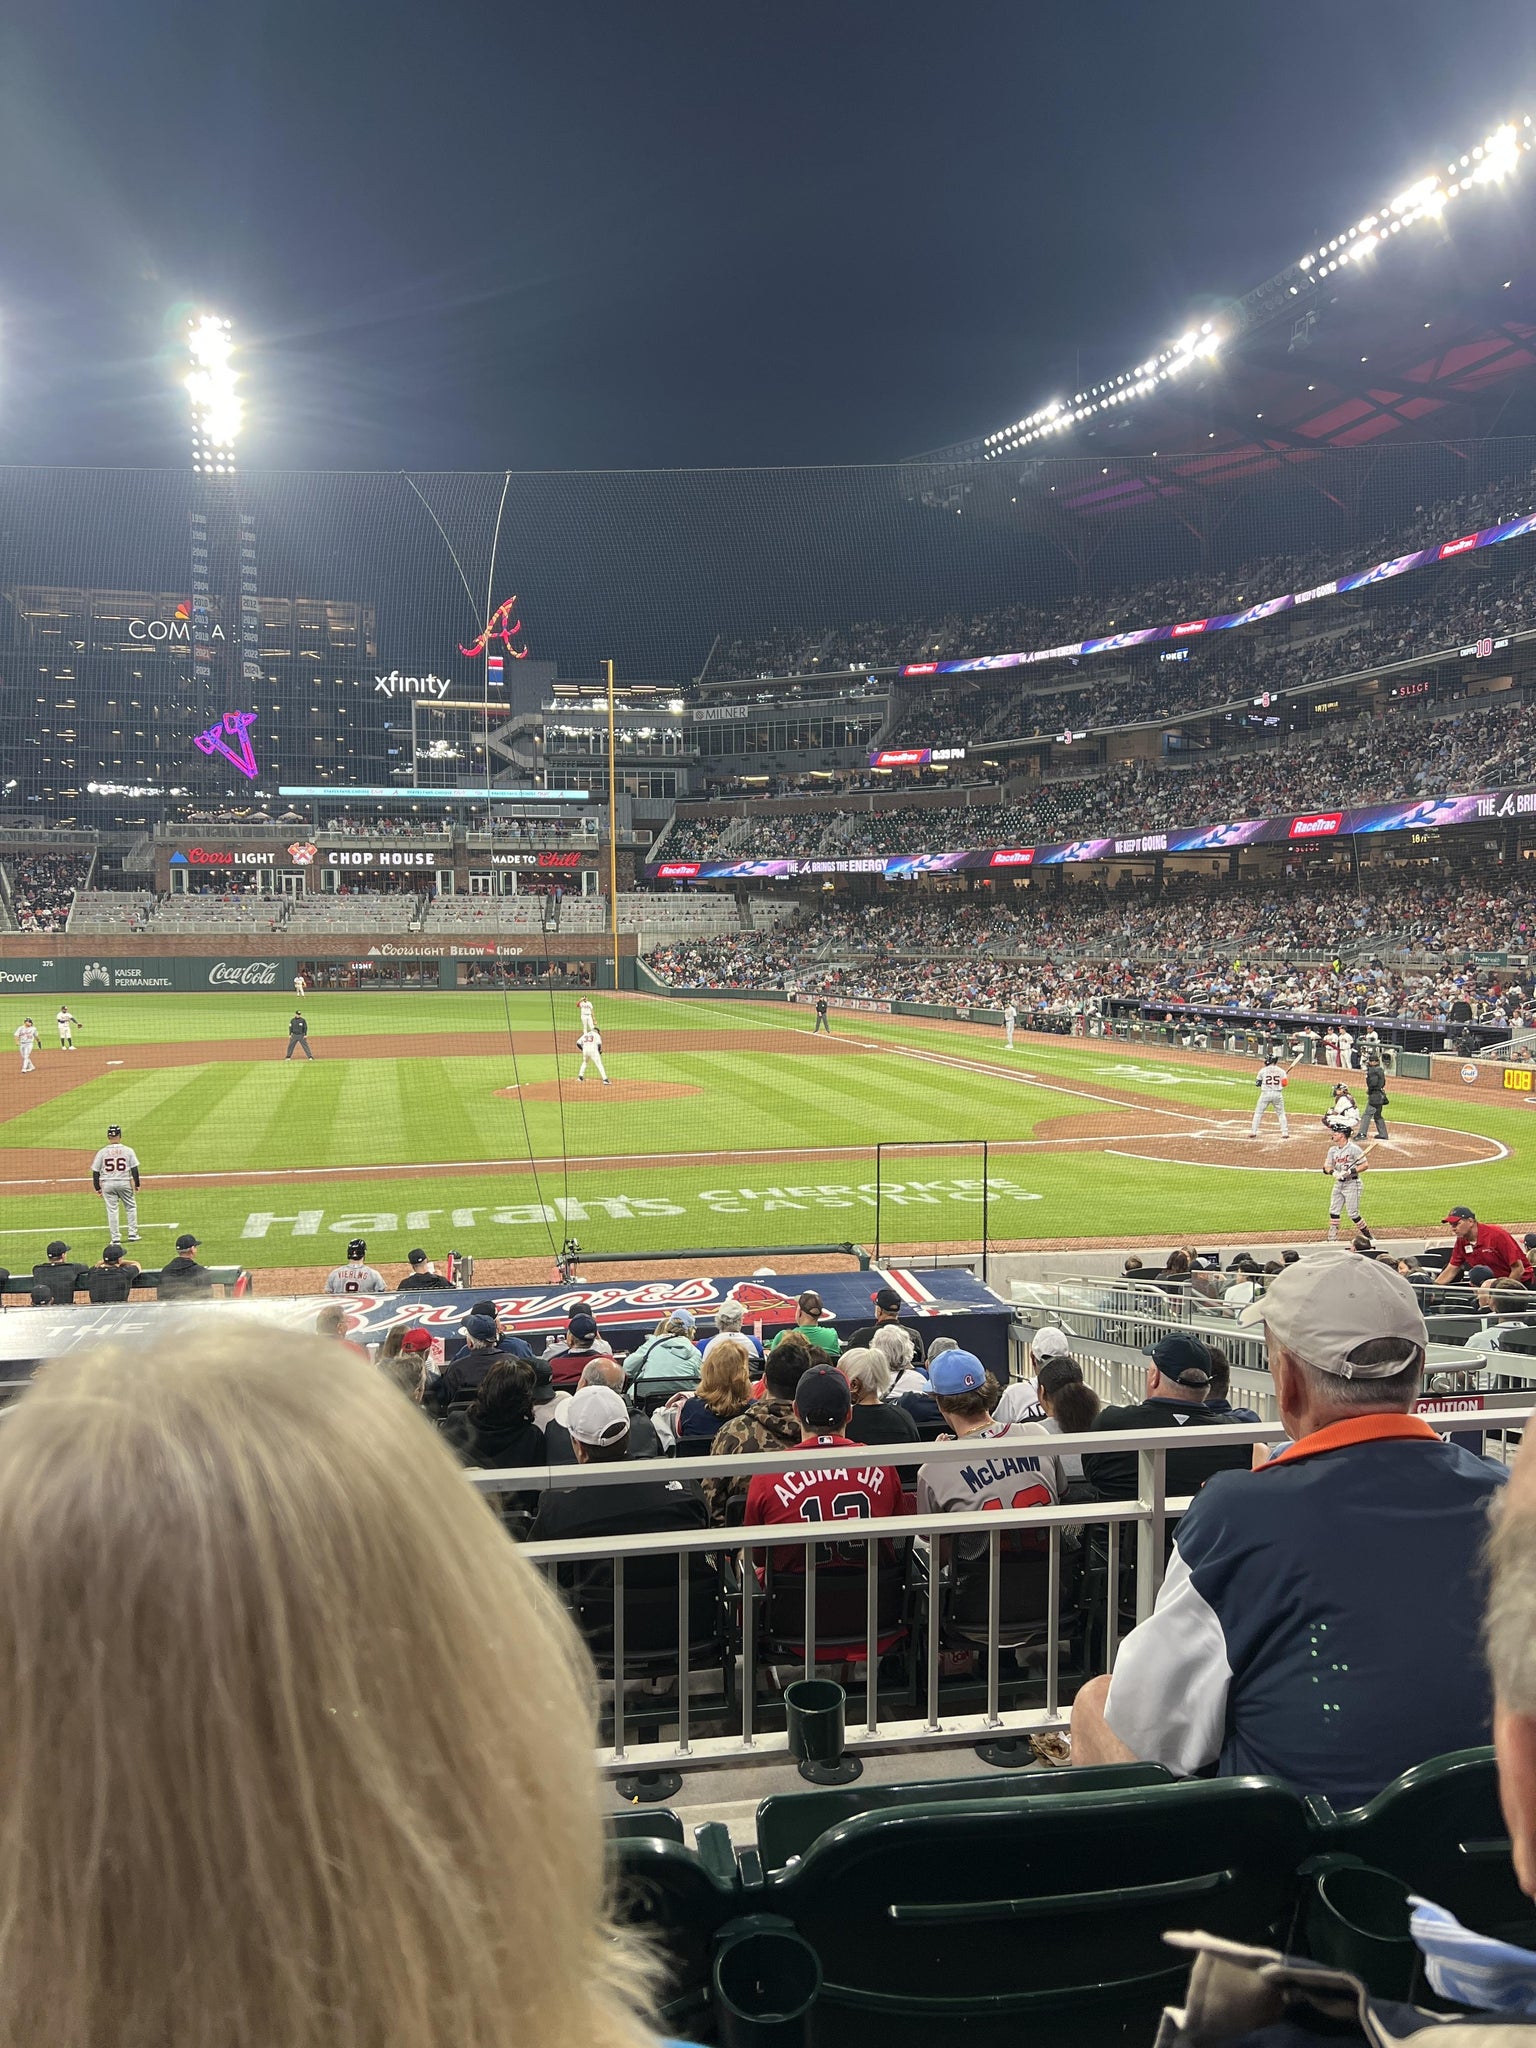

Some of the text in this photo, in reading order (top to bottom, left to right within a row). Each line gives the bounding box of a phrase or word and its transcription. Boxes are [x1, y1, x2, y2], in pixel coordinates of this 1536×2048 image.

[1477, 638, 1492, 658] 10
[375, 671, 450, 699] xfinity
[706, 707, 746, 719] MILNER
[1477, 799, 1496, 816] THE
[1294, 819, 1337, 834] RaceTrac
[1142, 835, 1167, 851] GOING
[188, 847, 275, 864] Coors LIGHT
[329, 852, 435, 865] CHOP HOUSE
[491, 852, 580, 867] MADE TO Chill
[994, 852, 1030, 863] RaceTrac
[662, 867, 695, 875] RaceTrac
[849, 859, 888, 872] ENERGY
[381, 943, 414, 956] Coors
[416, 948, 444, 956] LIGHT
[0, 972, 38, 983] Power
[115, 969, 141, 977] KAISER
[209, 962, 280, 985] Coca-Cola
[1265, 1075, 1280, 1086] 25
[104, 1158, 127, 1172] 56
[698, 1178, 1020, 1201] CHEROKEE
[709, 1188, 1043, 1213] CASINOS
[46, 1322, 152, 1337] THE
[1416, 1400, 1478, 1414] CAUTION
[857, 1466, 885, 1495] JR.
